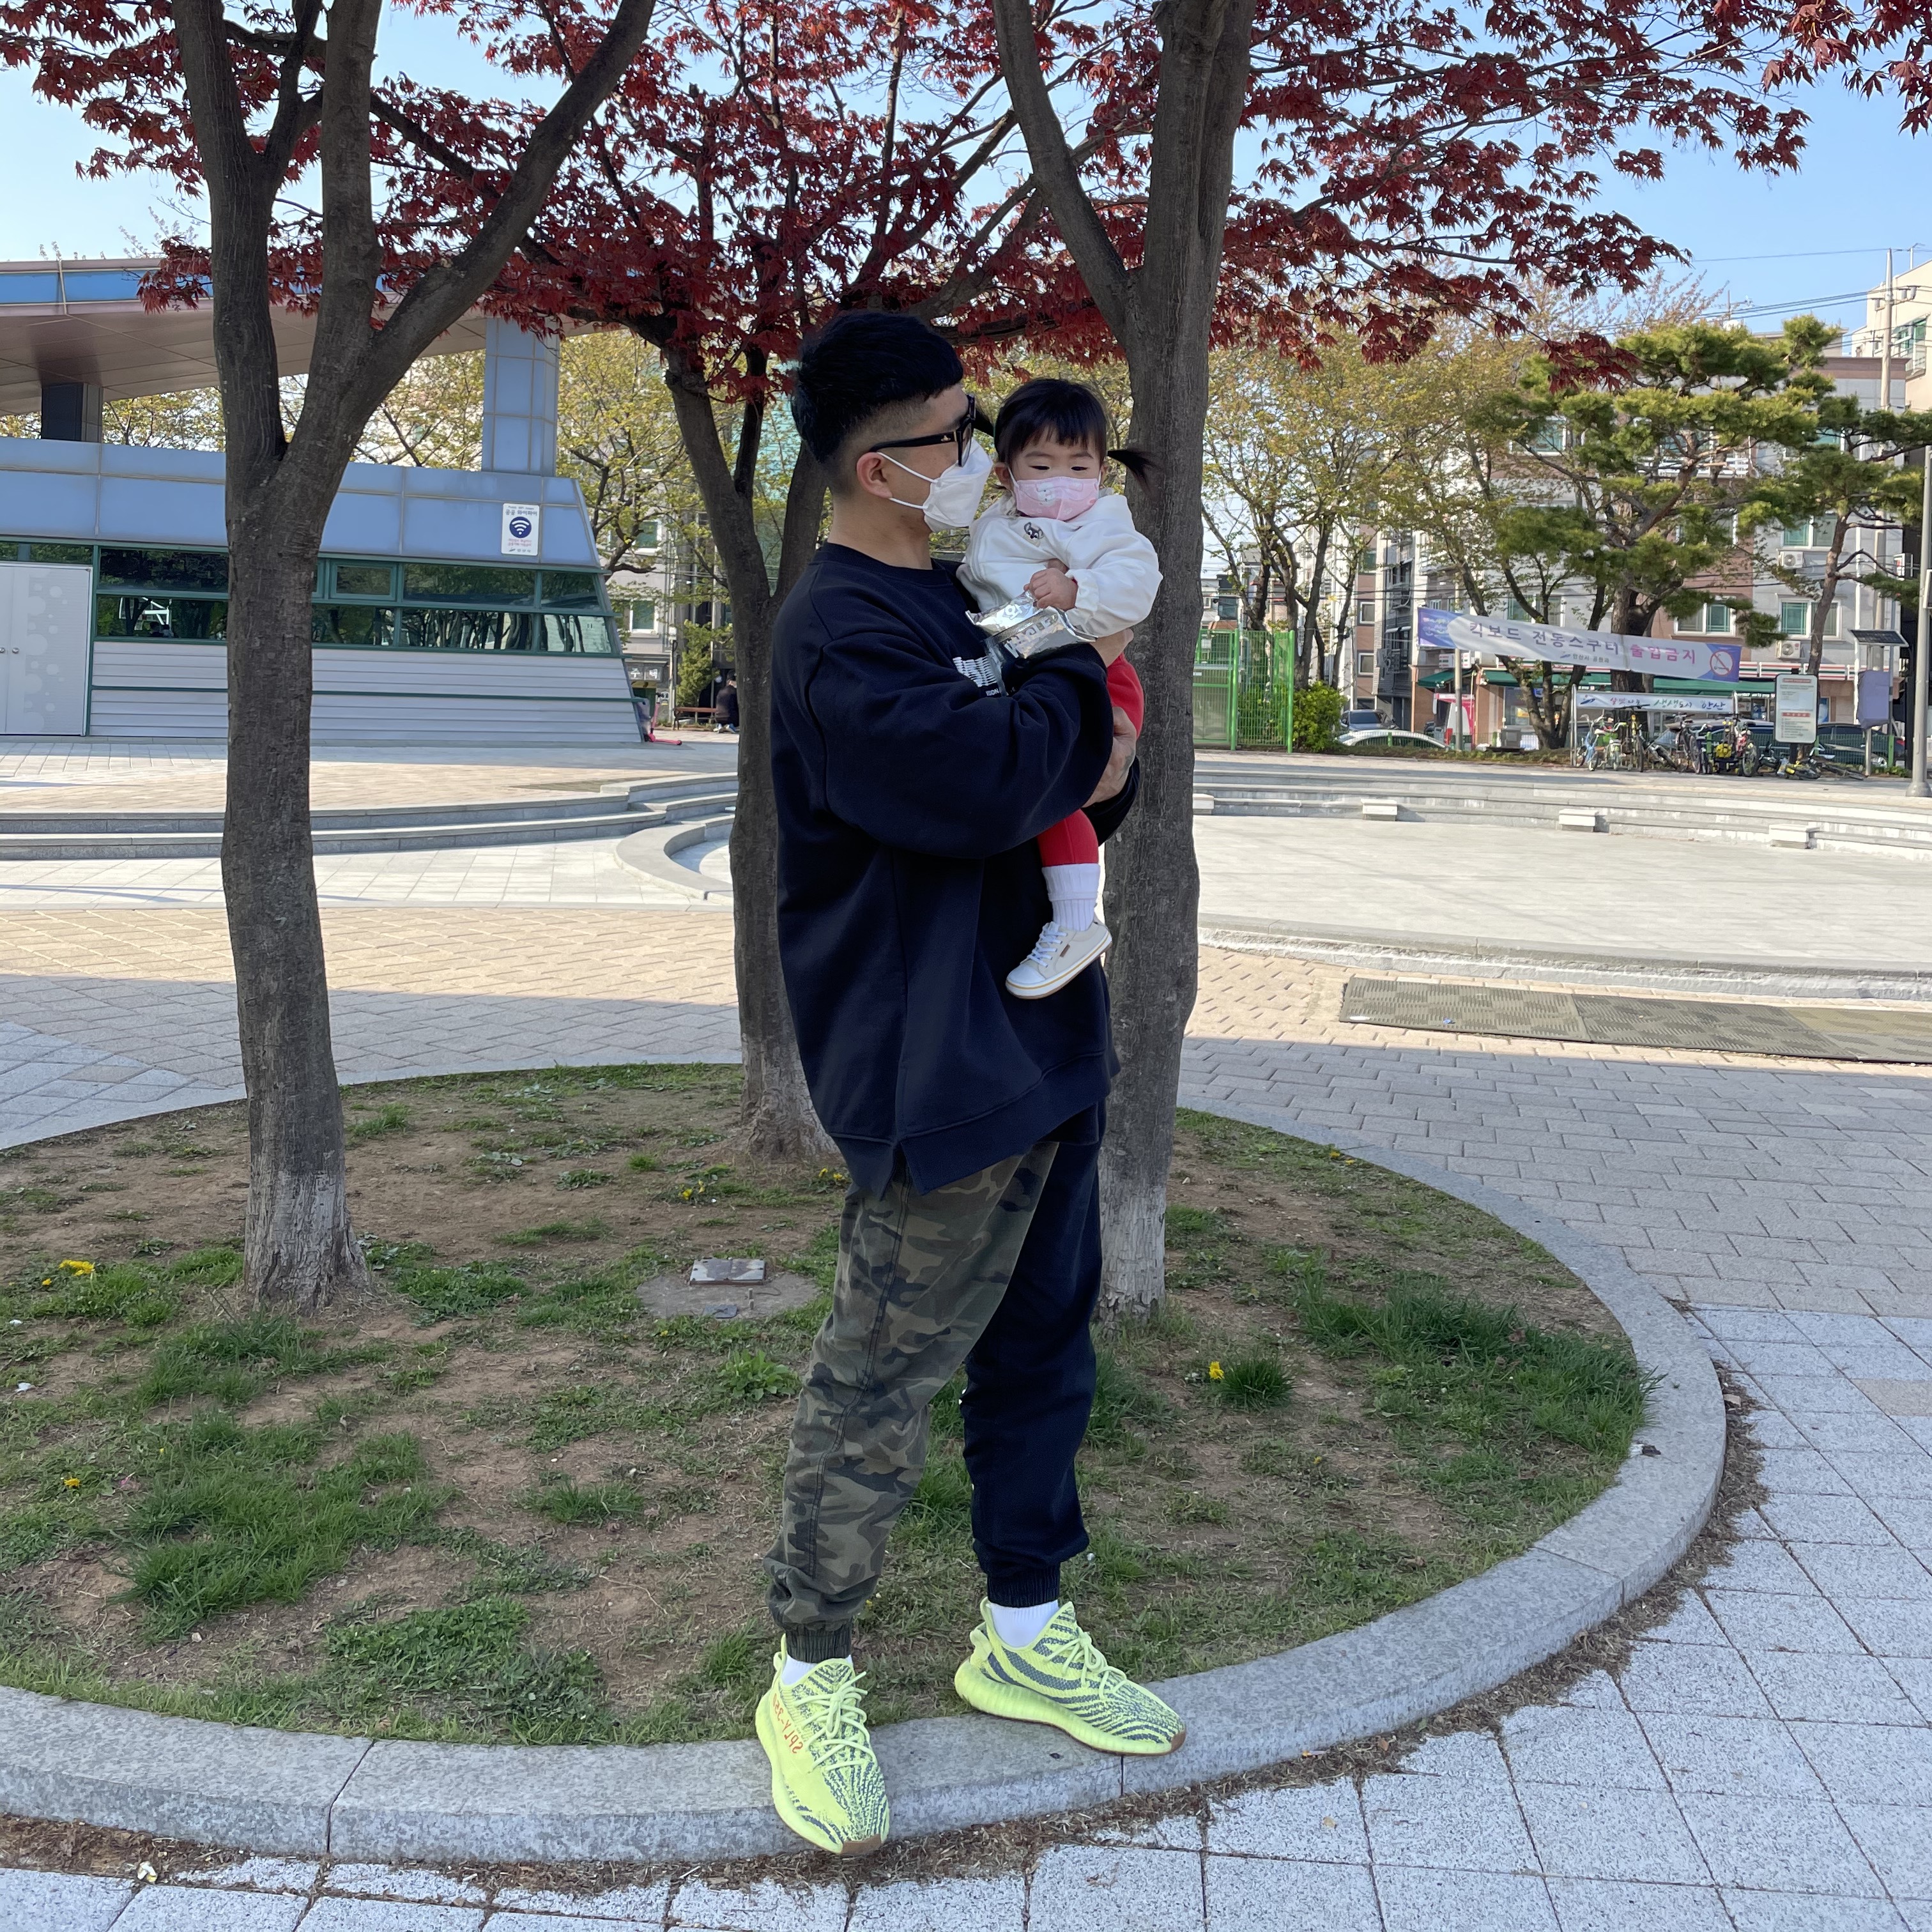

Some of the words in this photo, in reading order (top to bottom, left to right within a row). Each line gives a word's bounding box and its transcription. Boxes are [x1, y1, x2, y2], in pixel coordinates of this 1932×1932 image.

[1469, 622, 1522, 641] 킥보드
[1532, 630, 1620, 656] 전동스쿠터
[1630, 644, 1696, 664] 출입금지
